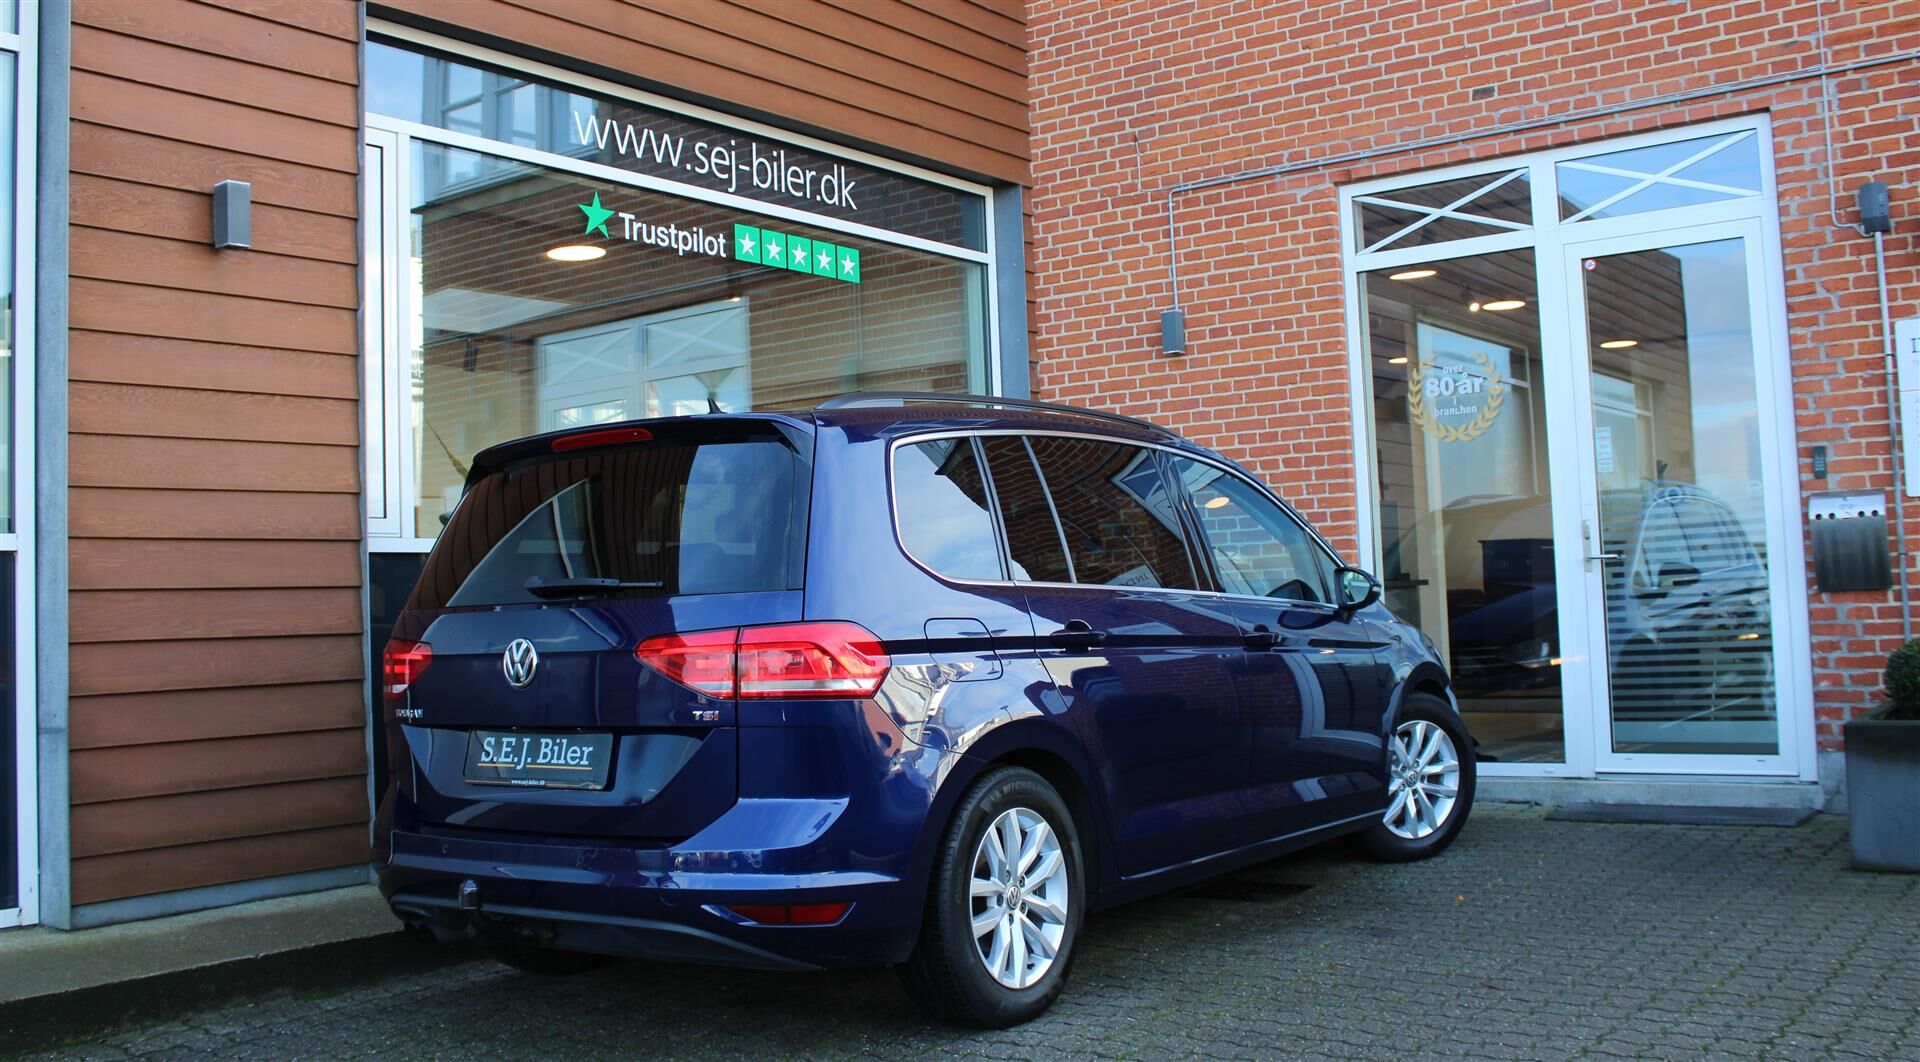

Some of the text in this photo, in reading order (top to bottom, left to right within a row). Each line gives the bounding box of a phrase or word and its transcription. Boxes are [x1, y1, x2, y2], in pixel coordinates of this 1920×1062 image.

[574, 111, 857, 210] www.sej-biler.dk
[618, 212, 727, 257] Trustpilot
[1424, 372, 1484, 398] 80 år
[1434, 405, 1478, 417] branchen
[692, 710, 719, 721] TSI
[480, 736, 594, 770] S.E.J. Biler
